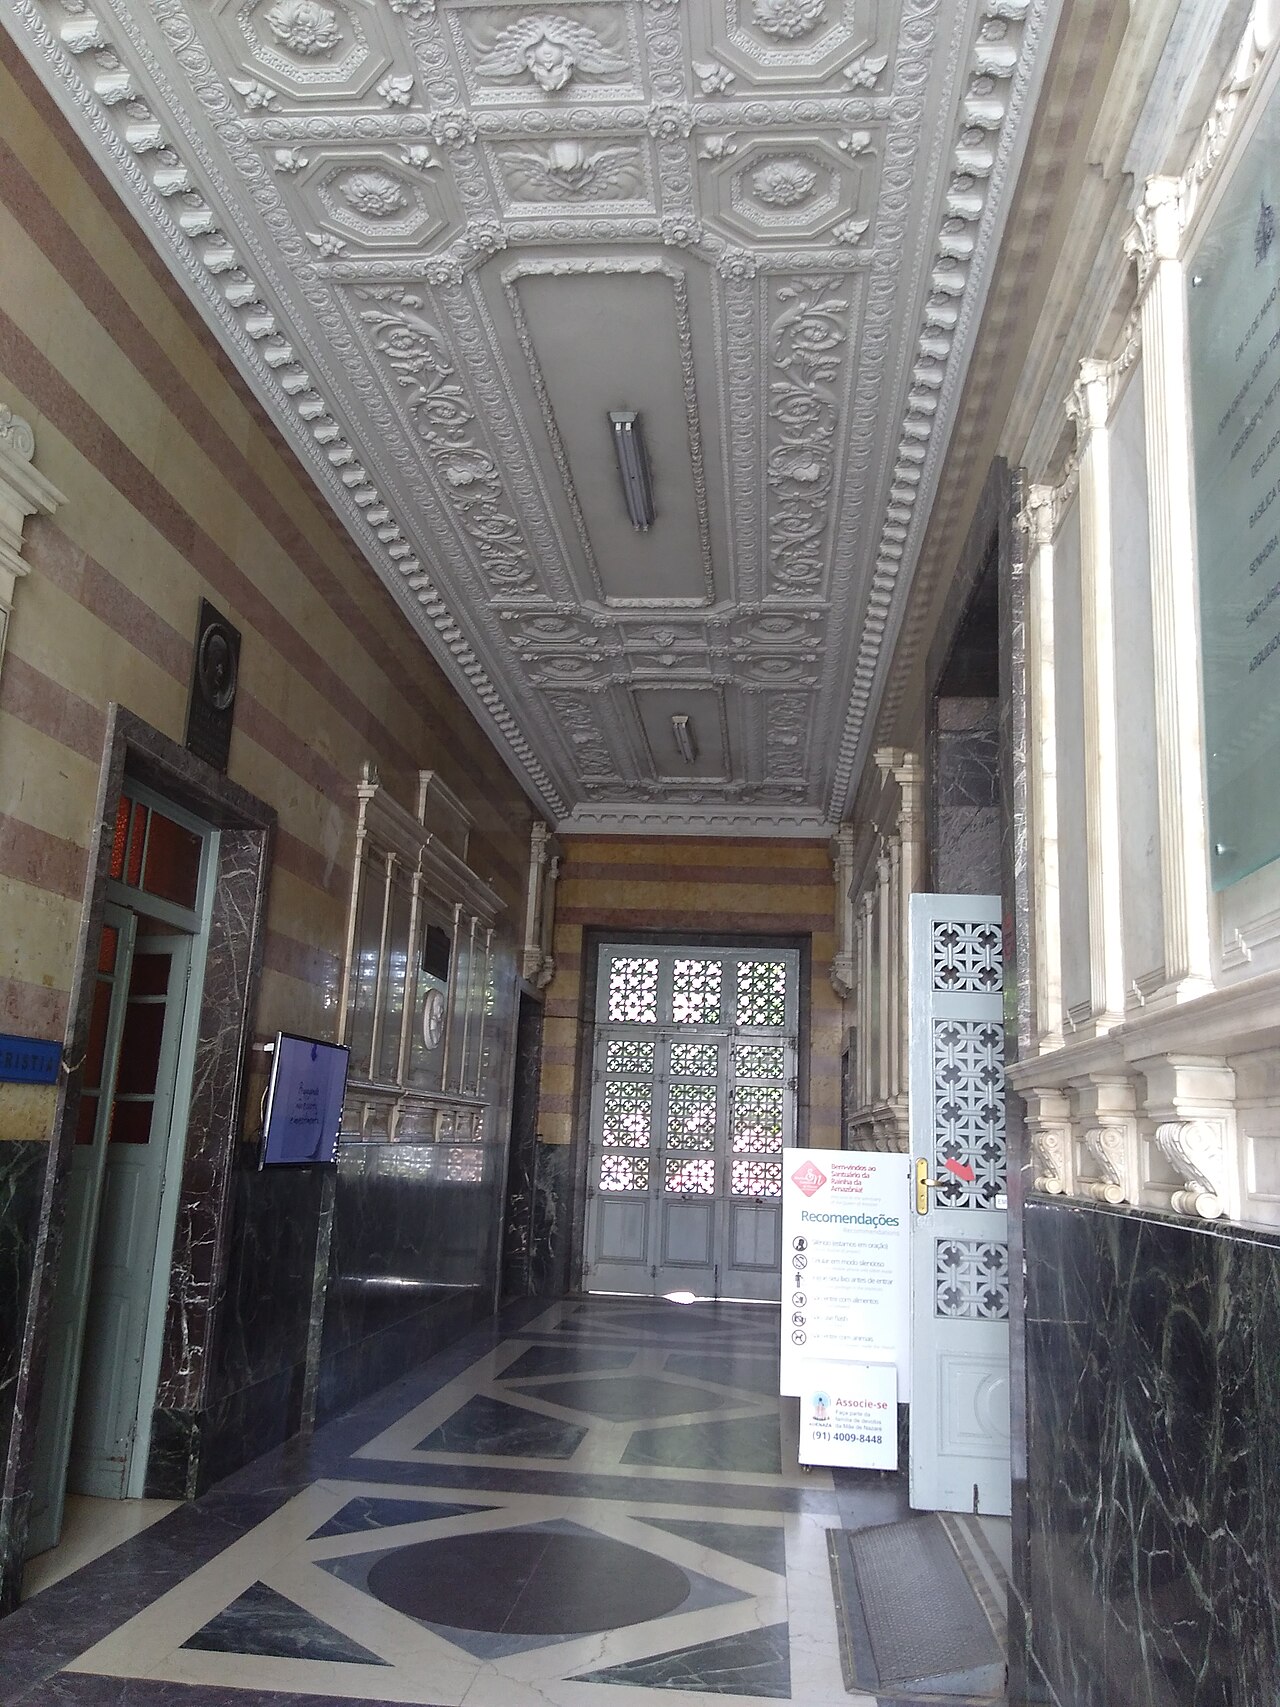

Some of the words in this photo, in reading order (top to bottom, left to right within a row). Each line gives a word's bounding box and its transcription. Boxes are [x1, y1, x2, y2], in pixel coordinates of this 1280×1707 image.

[1249, 535, 1279, 577] SENHORA
[831, 1164, 867, 1172] Bem-vindos
[801, 1210, 899, 1229] Recomendações
[836, 1398, 888, 1410] Associe-se
[812, 1431, 831, 1442] (91)
[833, 1432, 883, 1444] 4009-8448
